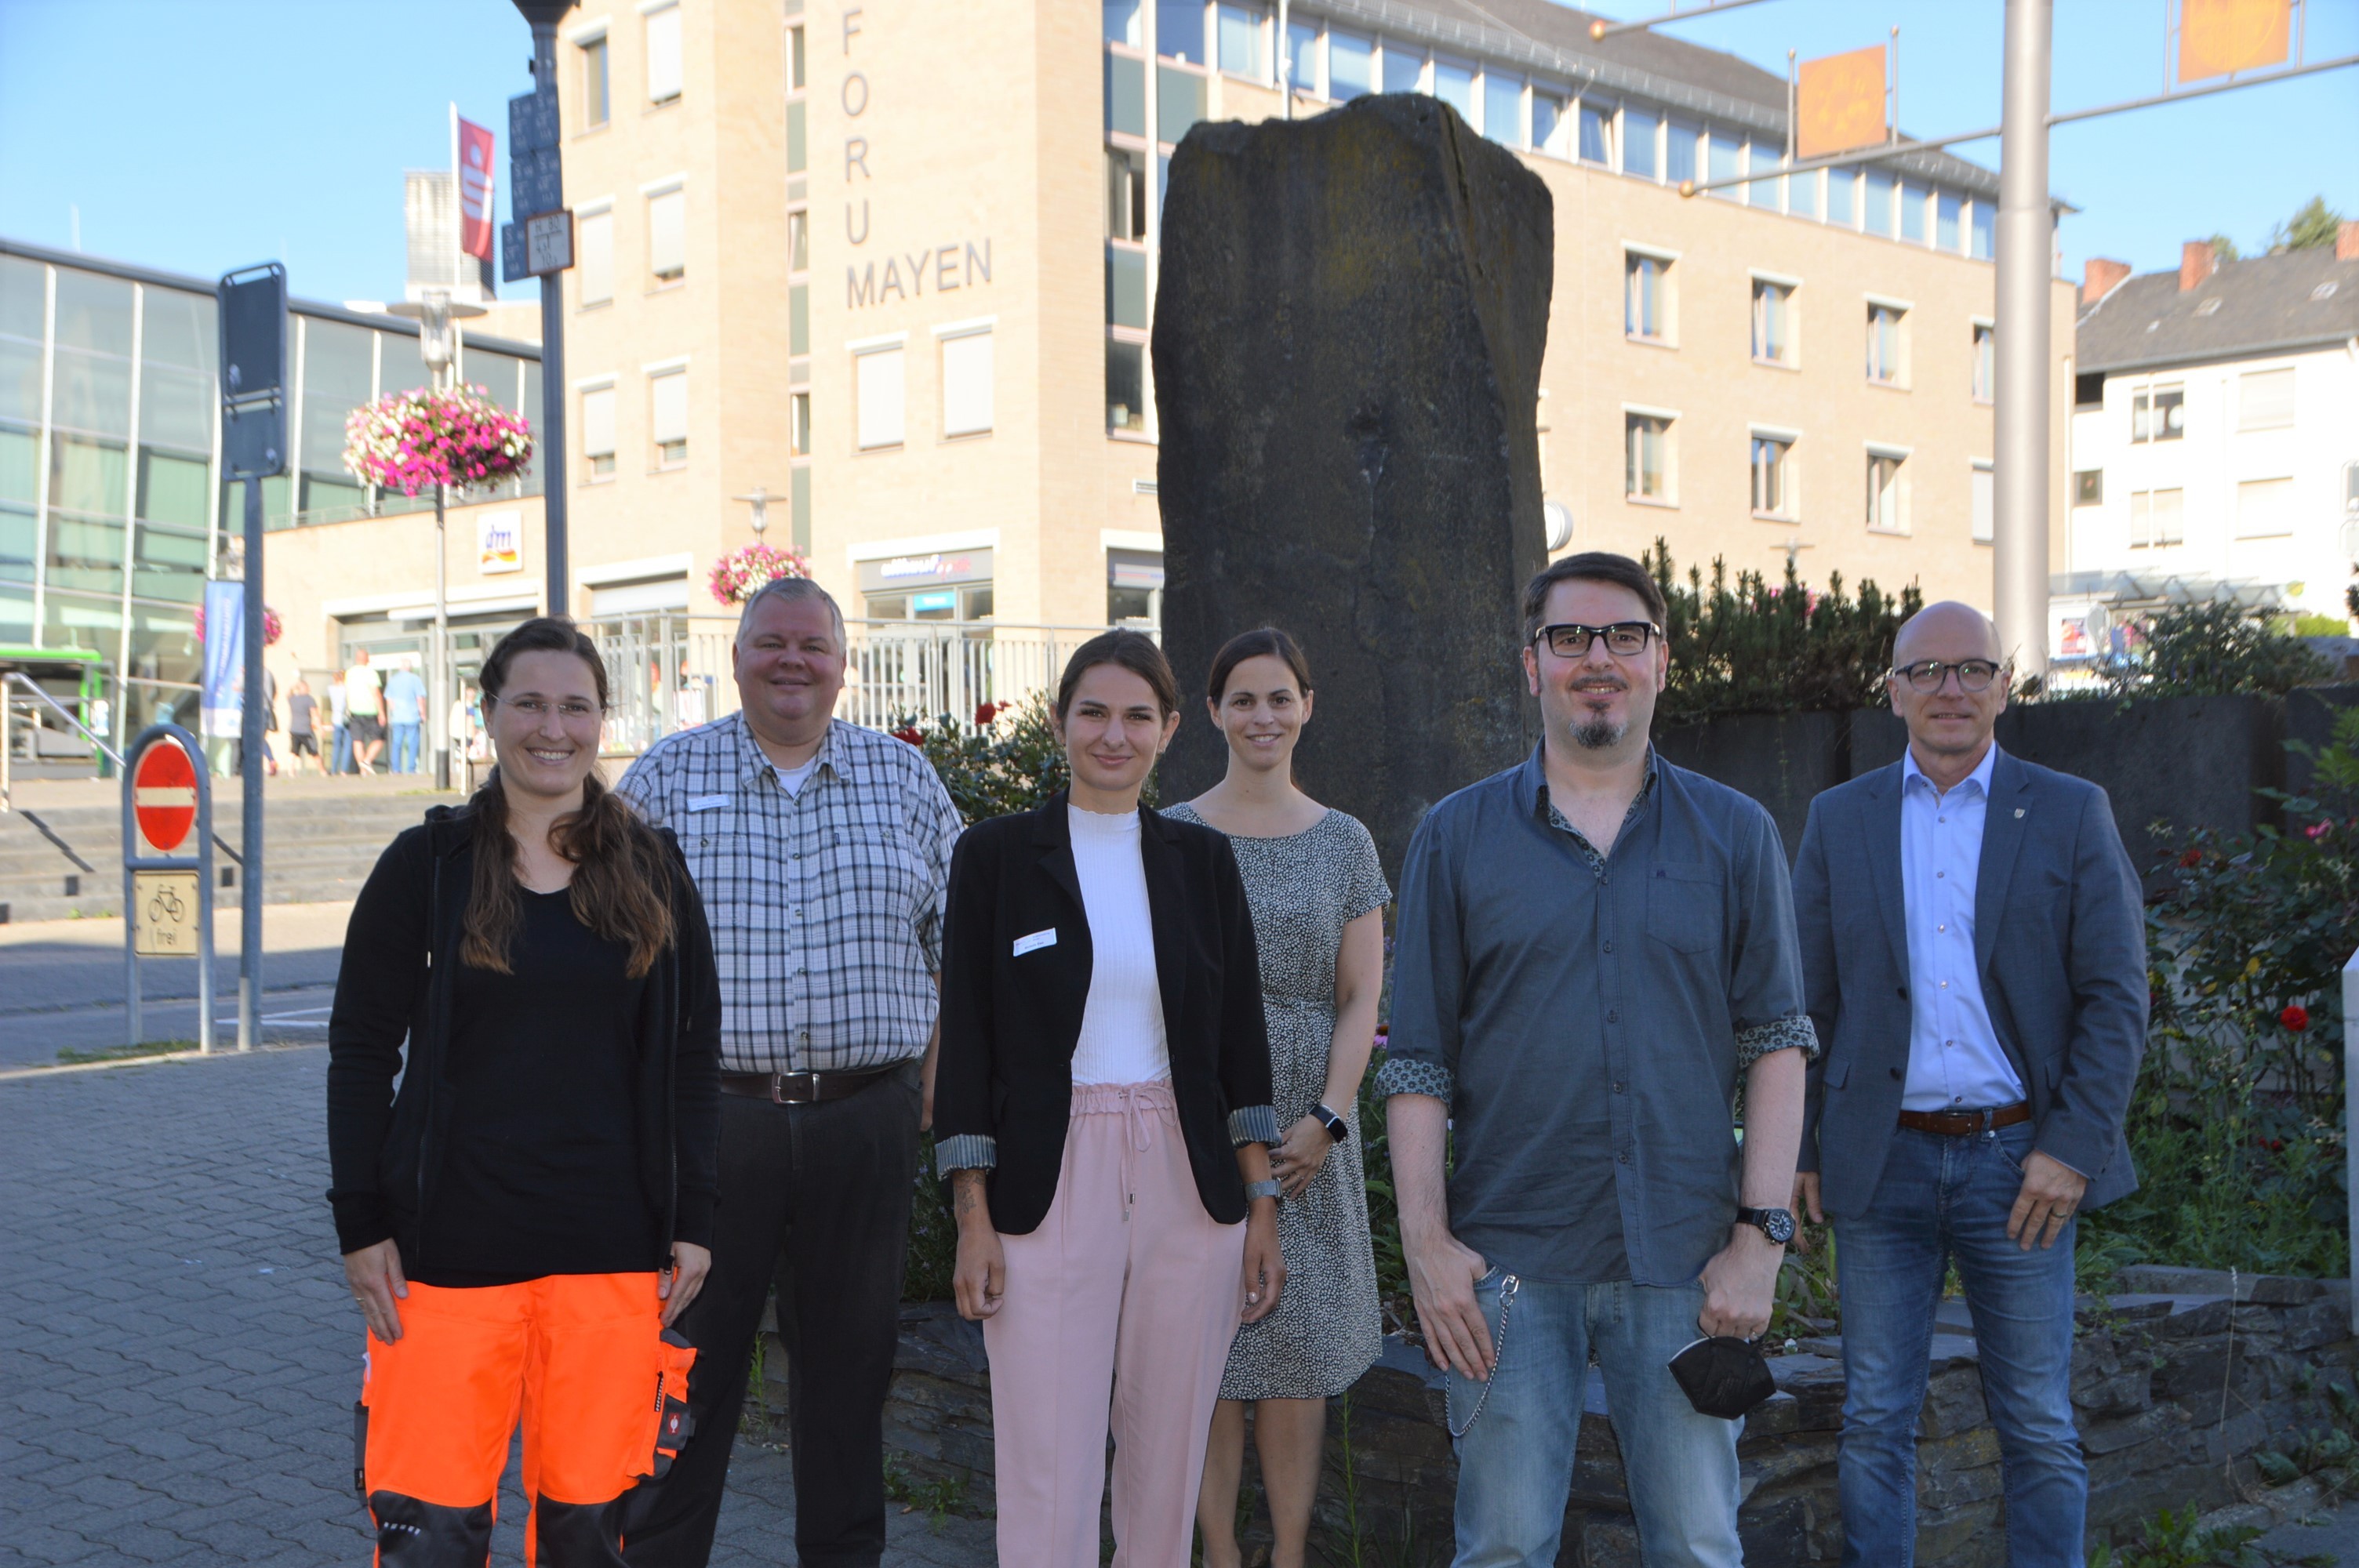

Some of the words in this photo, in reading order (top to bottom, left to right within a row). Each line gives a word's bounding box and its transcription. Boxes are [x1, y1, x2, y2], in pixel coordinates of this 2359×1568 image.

[847, 236, 992, 310] MAYEN
[485, 523, 512, 550] dm
[157, 927, 178, 946] frei
